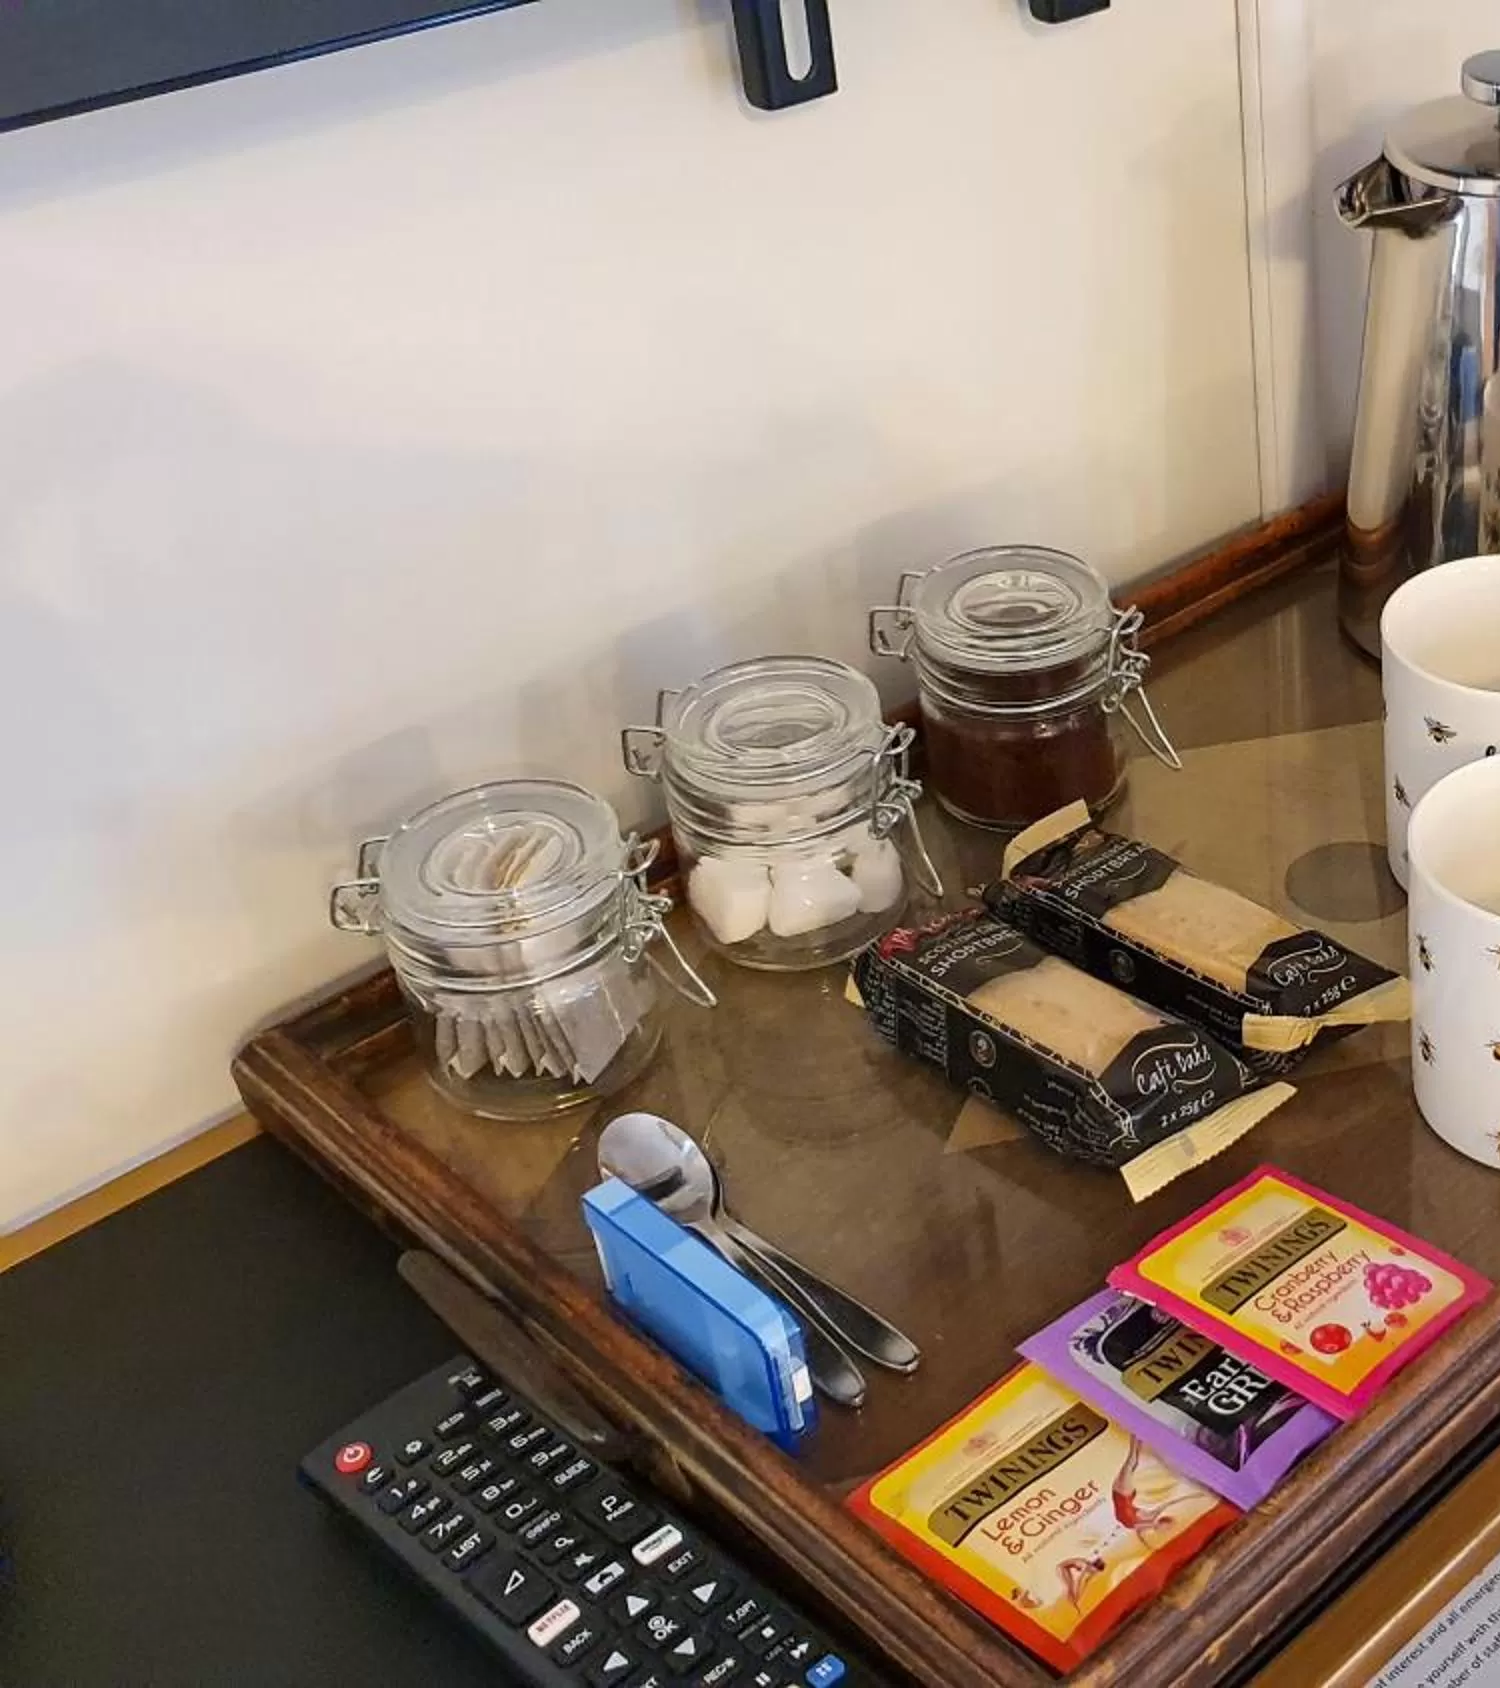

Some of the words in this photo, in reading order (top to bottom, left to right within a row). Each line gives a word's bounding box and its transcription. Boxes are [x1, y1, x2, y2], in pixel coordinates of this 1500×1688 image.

[931, 928, 1022, 977] SHORTBRE
[1215, 1217, 1332, 1298] TWININGS
[1255, 1250, 1338, 1312] Cranberry
[1207, 1365, 1273, 1415] GR
[943, 1417, 1090, 1522] TWININGS
[980, 1487, 1057, 1542] Lemon
[1019, 1479, 1100, 1537] Ginger
[451, 1531, 482, 1560] LIST
[667, 1550, 694, 1574] EXIT
[562, 1628, 593, 1655] BACK
[653, 1620, 679, 1641] OK
[1384, 1642, 1427, 1682] interest
[1426, 1623, 1448, 1645] and
[1446, 1610, 1461, 1626] all
[1424, 1642, 1468, 1685] yourself
[1467, 1622, 1491, 1645] with
[1471, 1654, 1484, 1670] of
